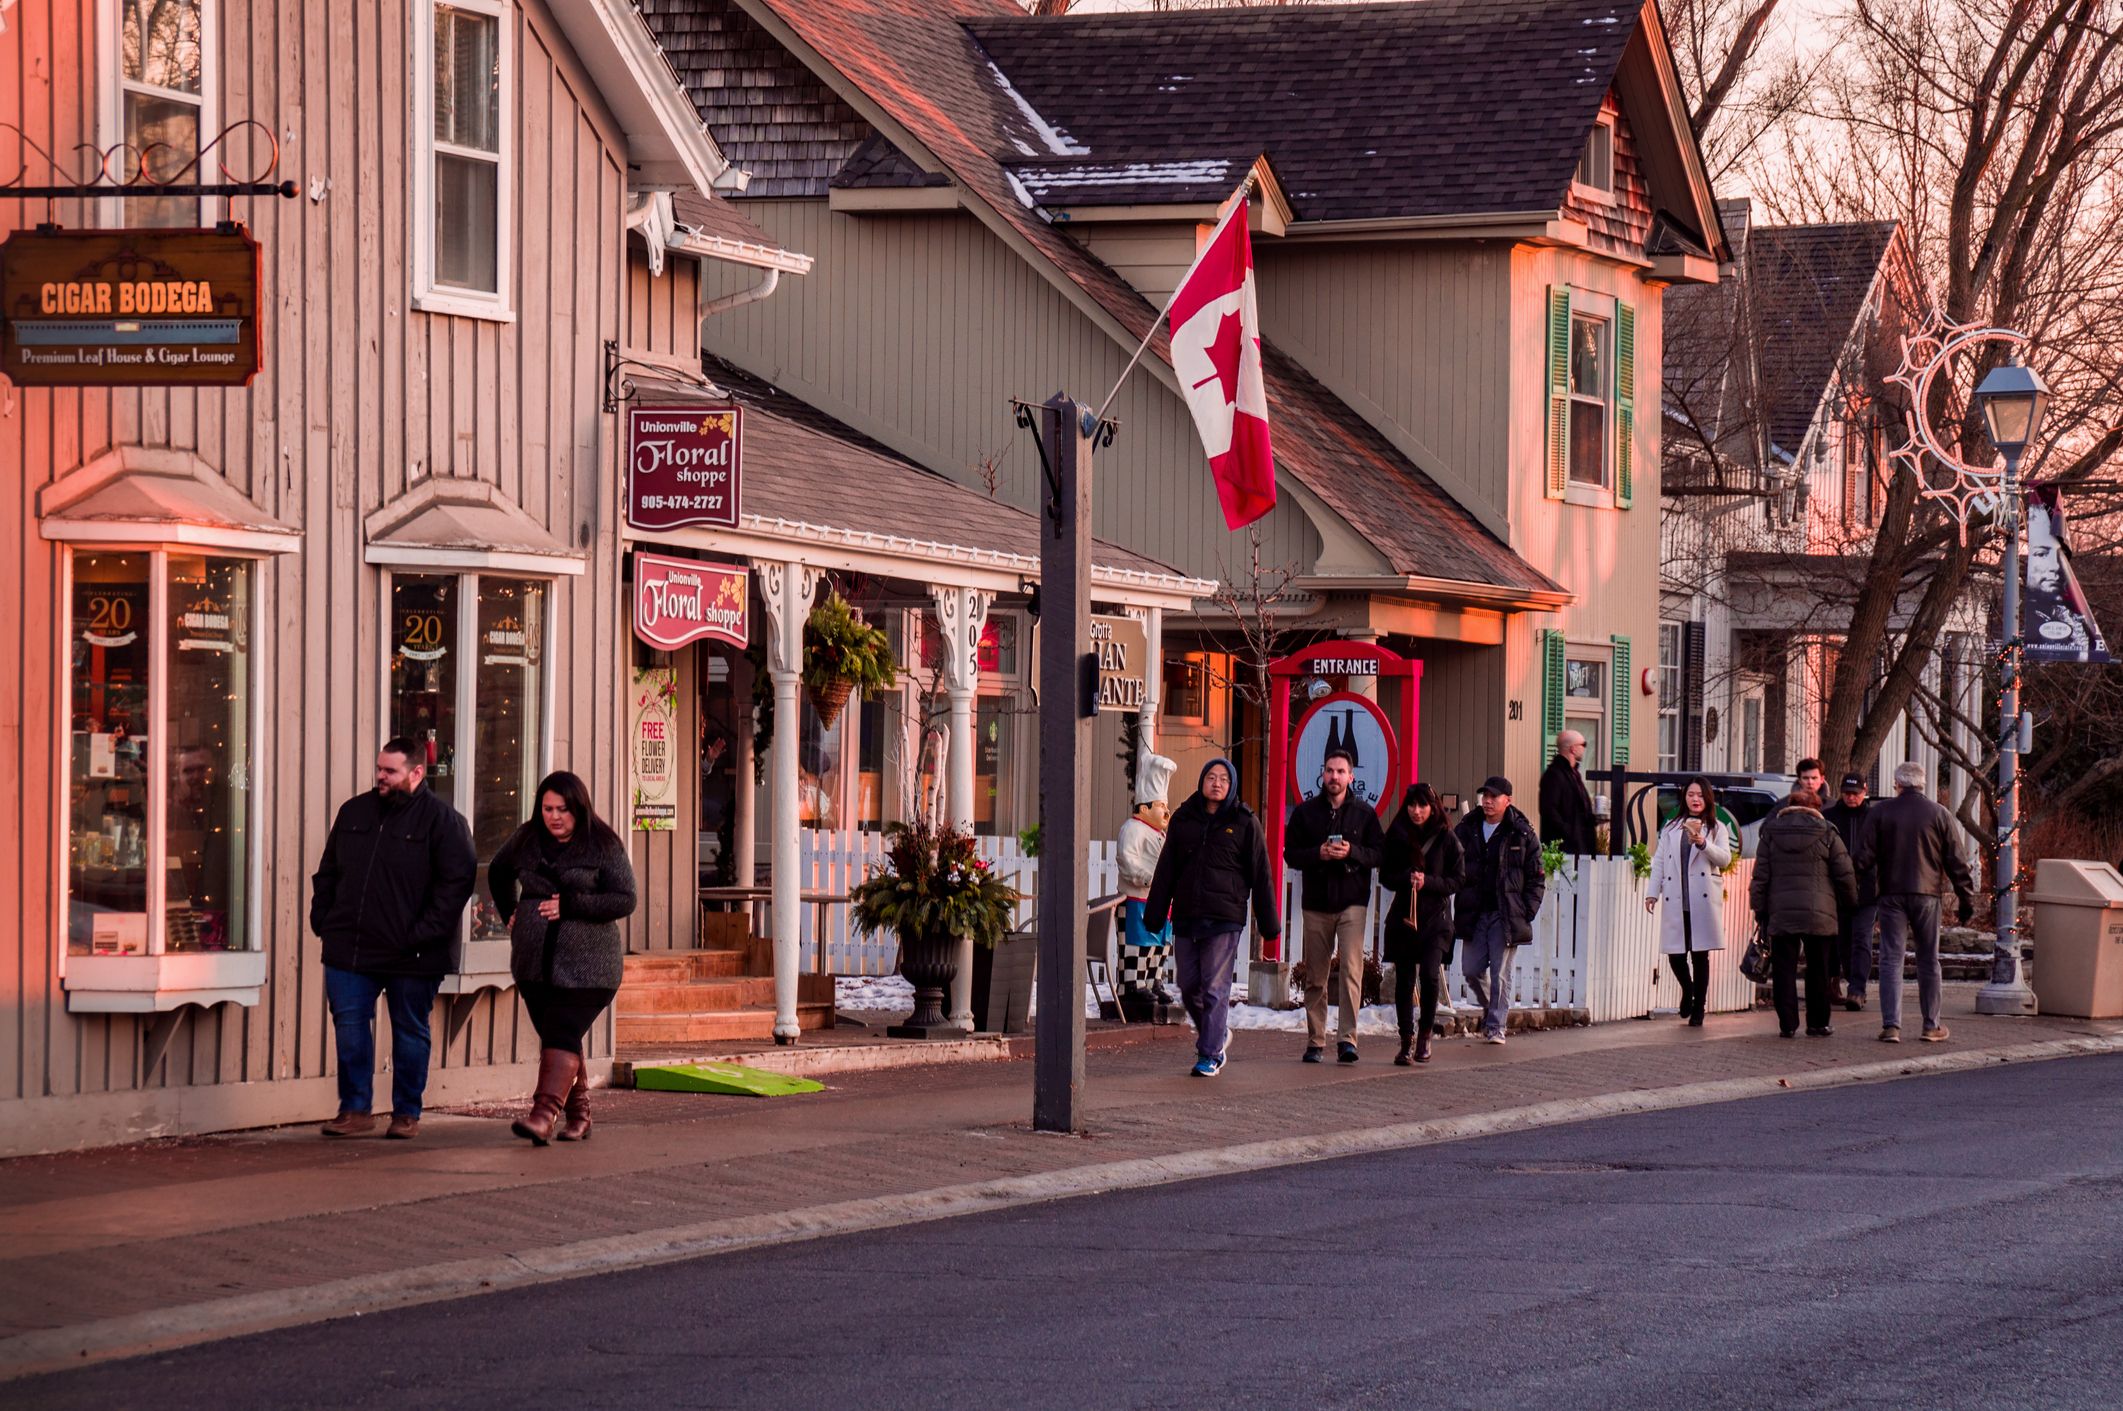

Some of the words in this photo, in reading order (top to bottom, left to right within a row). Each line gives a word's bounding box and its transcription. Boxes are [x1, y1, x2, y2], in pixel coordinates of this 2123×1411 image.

[41, 283, 112, 314] CIGAR
[119, 281, 214, 313] BODEGA
[21, 349, 76, 363] Premium
[78, 349, 104, 366] Leaf
[107, 349, 142, 363] House
[145, 349, 156, 363] &
[158, 348, 190, 365] Cigar
[192, 347, 235, 365] Lounge
[640, 421, 697, 433] Unionville
[636, 440, 730, 473] Floral
[676, 467, 727, 488] shoppe
[641, 495, 723, 509] 905-474-2727
[668, 570, 701, 585] Unionville
[90, 597, 131, 629] 20
[643, 579, 703, 626] Floral
[706, 601, 742, 632] shoppe
[405, 615, 442, 644] 20
[968, 595, 977, 676] 205
[1090, 619, 1112, 639] Grotta
[1313, 659, 1377, 674] ENTRANCE
[1508, 699, 1523, 721] 201
[642, 722, 665, 739] FREE
[642, 741, 666, 757] FLOWER
[642, 758, 665, 774] DELIVERY
